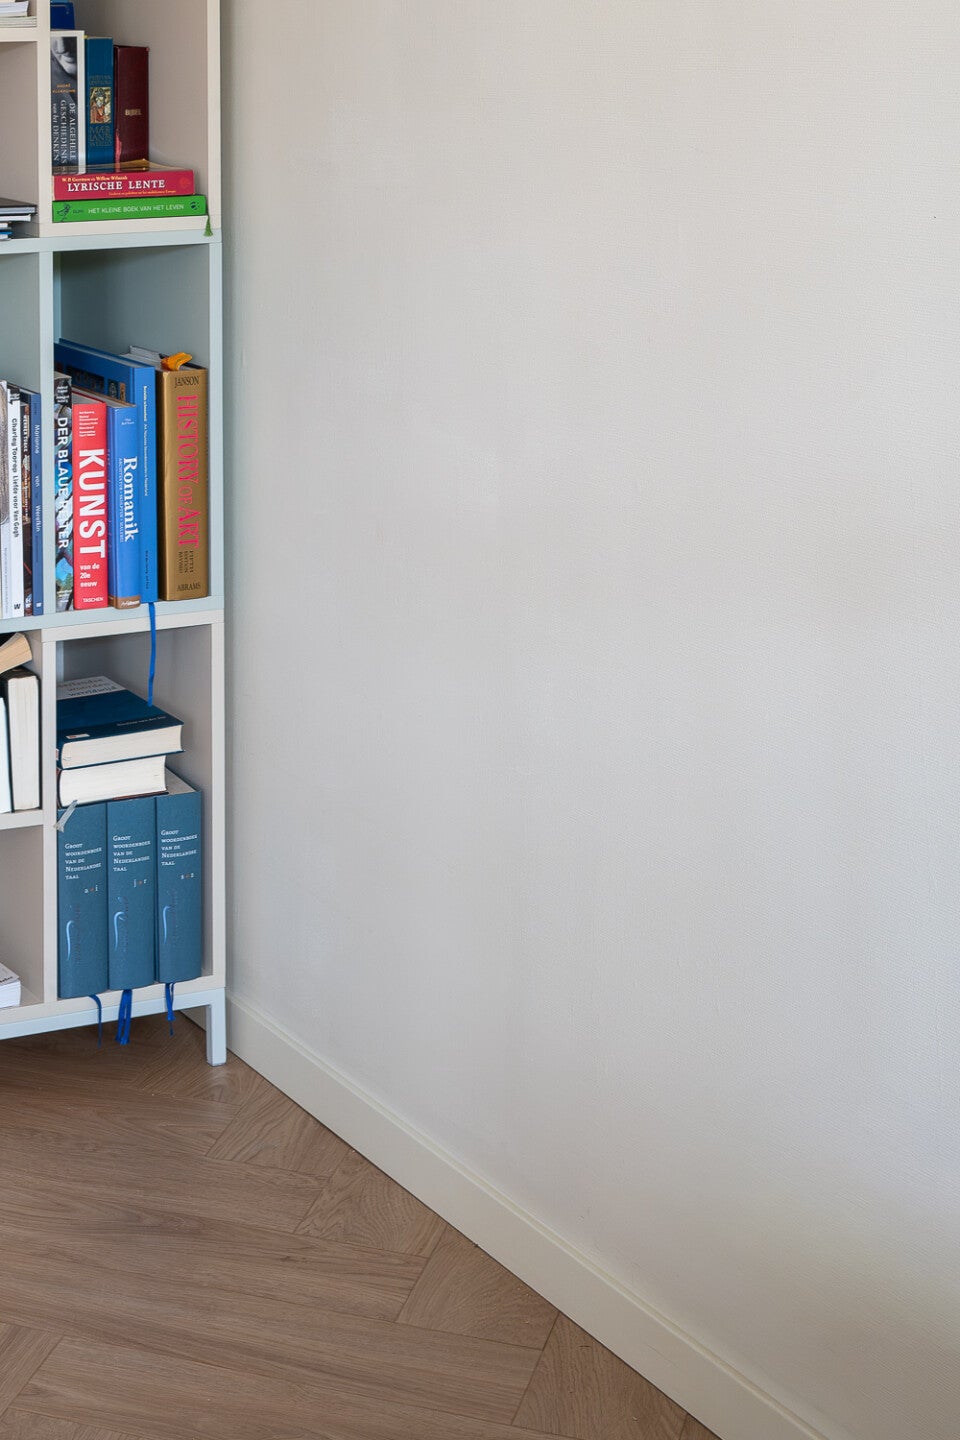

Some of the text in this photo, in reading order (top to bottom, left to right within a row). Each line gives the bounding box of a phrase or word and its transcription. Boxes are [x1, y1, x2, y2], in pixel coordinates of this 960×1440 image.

[69, 102, 76, 114] DE
[52, 125, 60, 161] DENKEN
[60, 99, 68, 164] GESCHIEDENIS
[67, 181, 123, 193] LYRISCHE
[129, 179, 166, 190] LENTE
[174, 375, 199, 389] JANSON
[10, 418, 18, 448] Charley
[57, 417, 68, 446] DER
[11, 448, 19, 474] Toorop
[57, 448, 69, 498] BLAUE
[177, 394, 201, 550] HISTORY OF ART
[78, 448, 106, 558] KUNST
[123, 456, 139, 542] Romanik
[12, 522, 20, 539] Gogh
[80, 580, 98, 588] eeuw
[177, 582, 201, 592] ABRAMS
